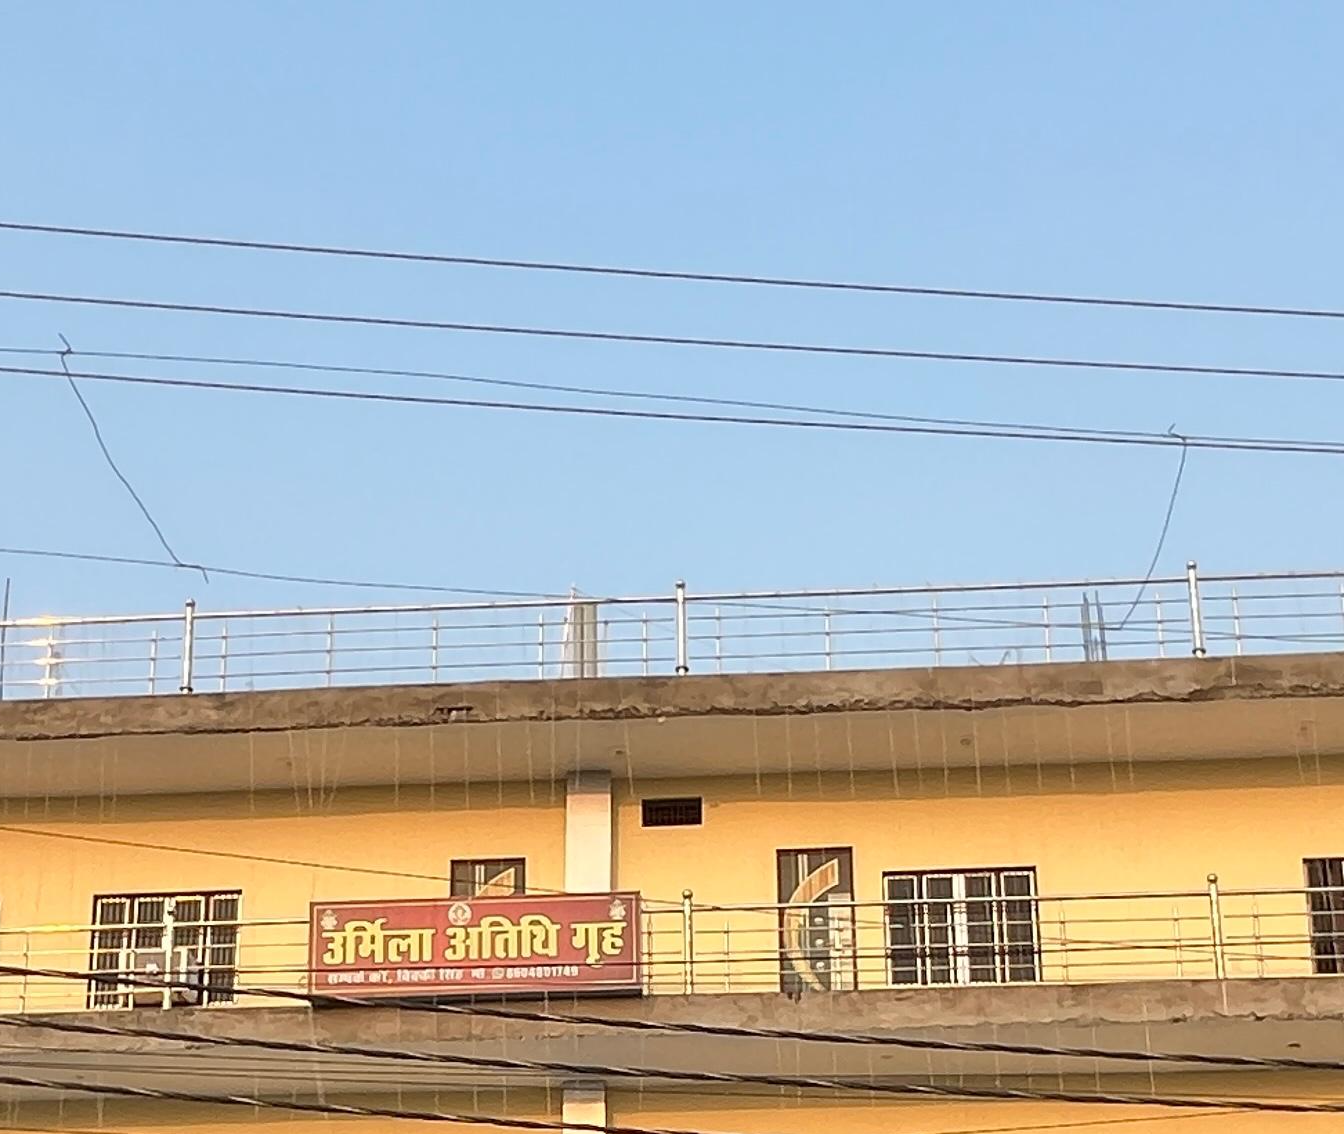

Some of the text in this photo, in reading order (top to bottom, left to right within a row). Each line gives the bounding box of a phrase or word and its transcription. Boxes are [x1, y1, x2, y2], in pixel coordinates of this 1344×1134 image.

[321, 914, 627, 969] उर्मिला अतिथि गृह
